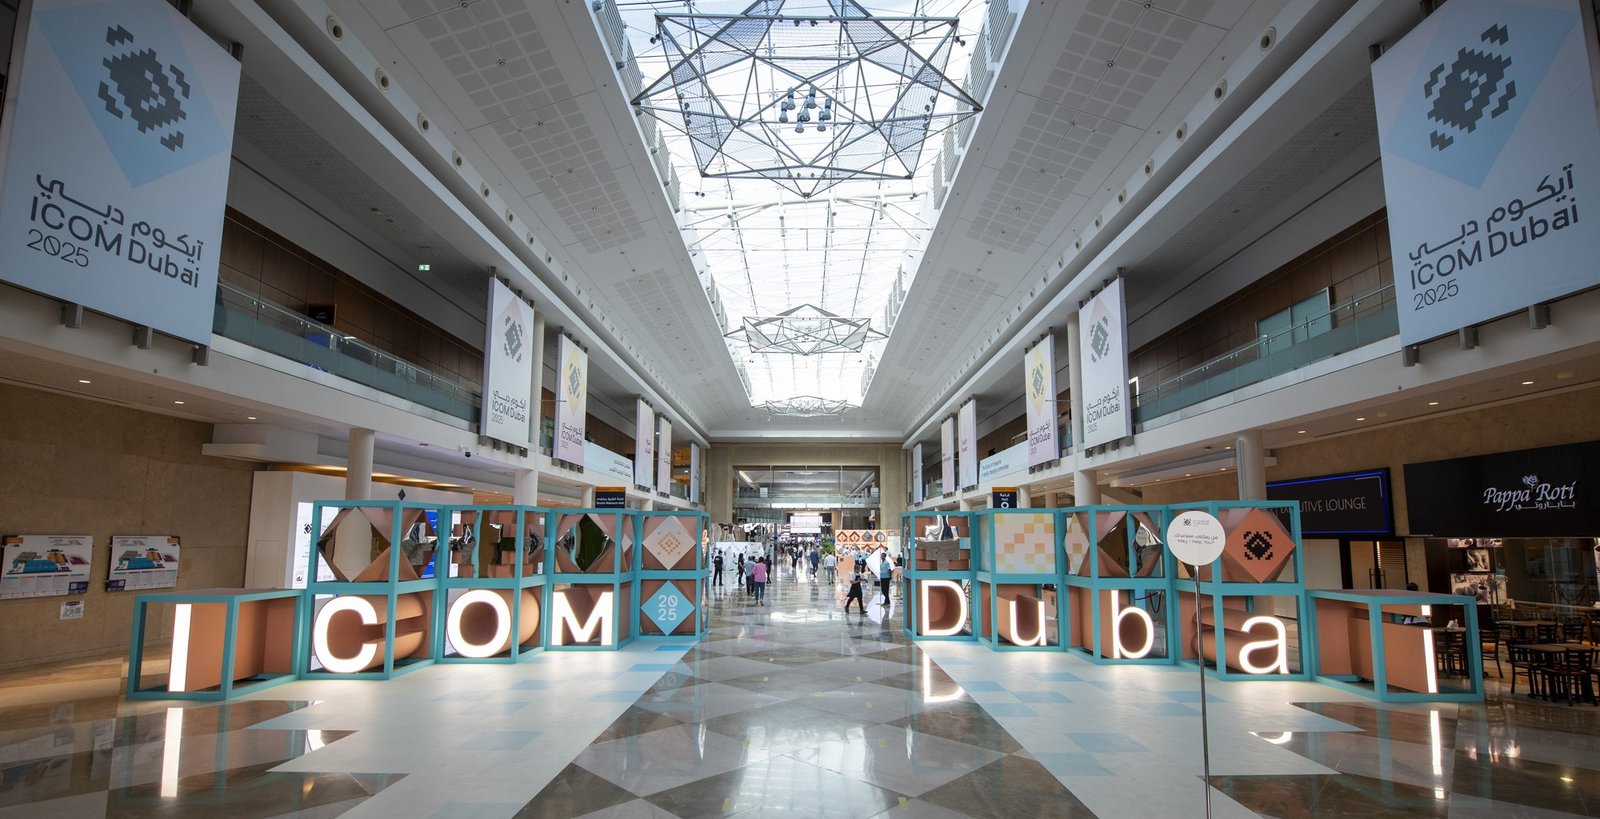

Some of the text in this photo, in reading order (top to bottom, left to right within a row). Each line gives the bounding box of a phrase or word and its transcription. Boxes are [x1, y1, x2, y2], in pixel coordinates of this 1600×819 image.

[36, 173, 205, 264] آيكوم دبي
[1409, 163, 1574, 266] آيكوم دبي
[26, 228, 89, 268] 2025
[30, 196, 200, 288] ICOM Dubai
[1410, 197, 1579, 290] ICOM Dubai
[1413, 279, 1459, 311] 2025
[491, 412, 503, 425] 2025
[492, 400, 526, 423] ICOM Dubai
[1087, 403, 1120, 424] ICOM Dubai
[1087, 423, 1098, 434] 2025
[1325, 496, 1367, 512] LOUNGE
[1483, 481, 1577, 512] Pappa Roti
